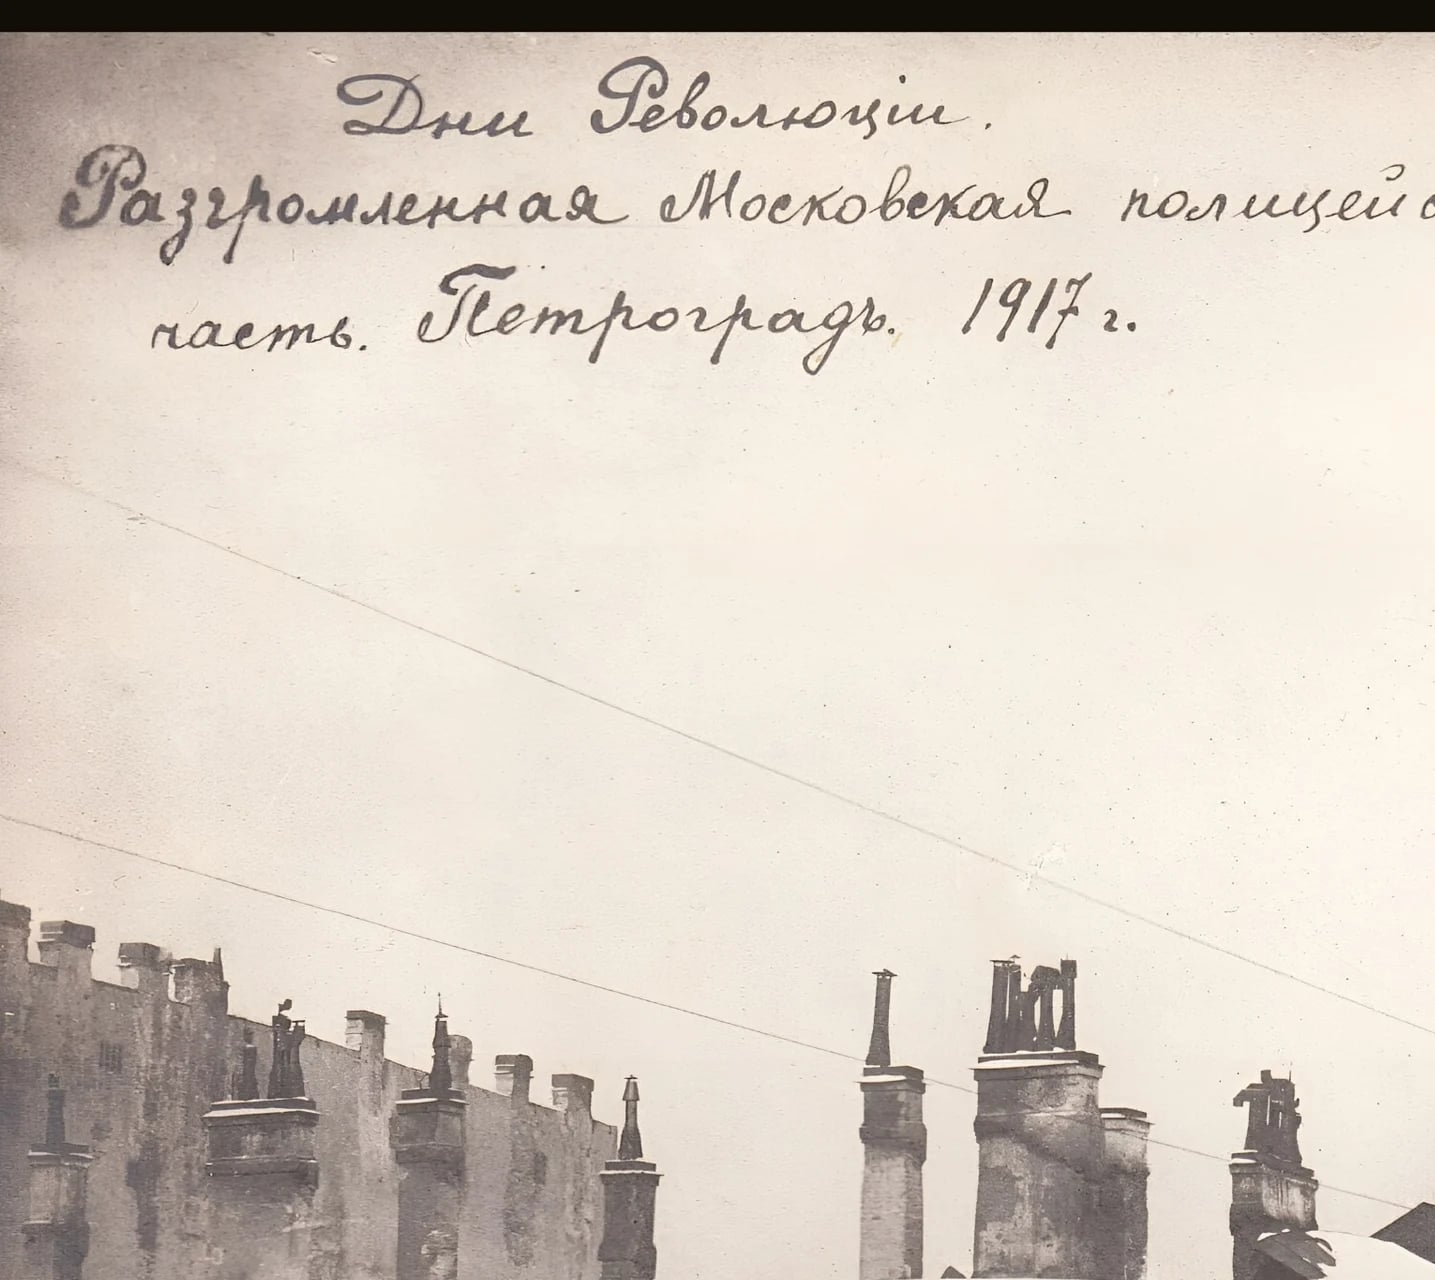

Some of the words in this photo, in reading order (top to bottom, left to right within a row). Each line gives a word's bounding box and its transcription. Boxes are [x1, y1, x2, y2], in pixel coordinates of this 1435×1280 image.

[337, 74, 534, 139] Дни
[59, 145, 629, 266] Разгромленная
[660, 165, 1073, 226] Московская
[151, 313, 369, 353] часть.
[417, 264, 896, 377] Петроградъ.
[961, 272, 1093, 350] 1917
